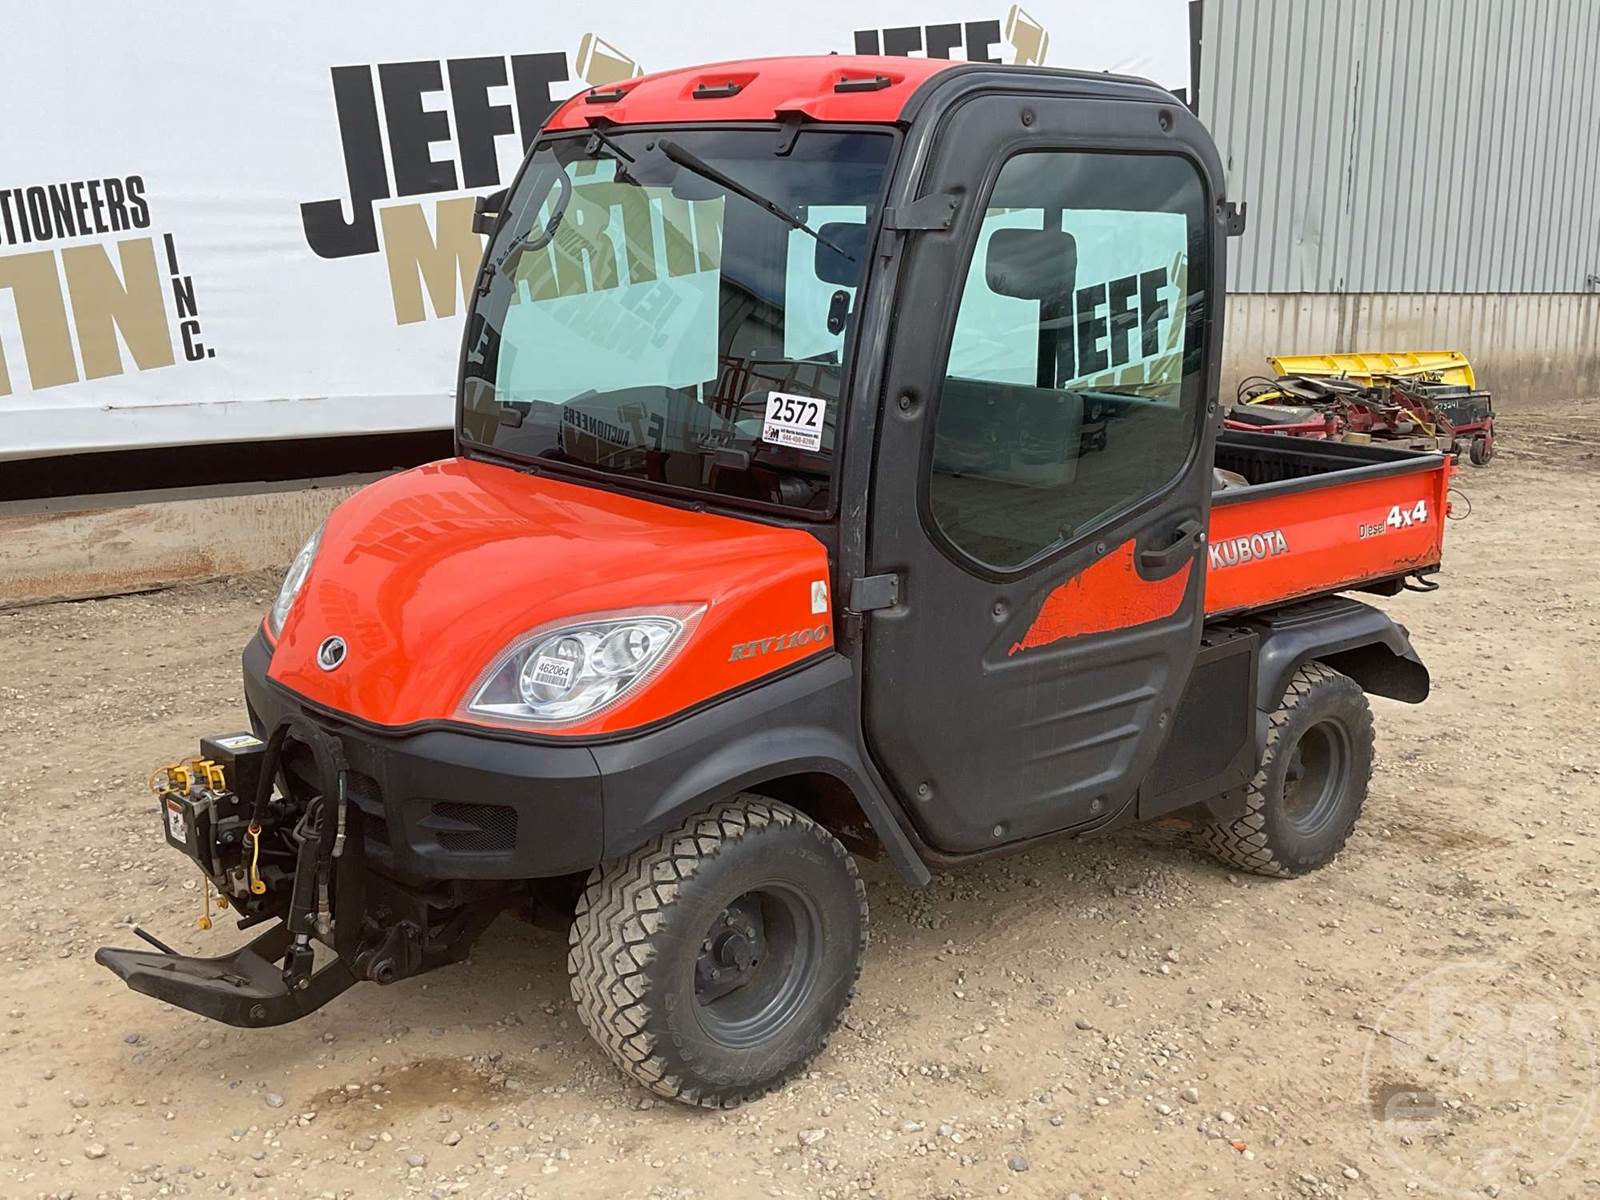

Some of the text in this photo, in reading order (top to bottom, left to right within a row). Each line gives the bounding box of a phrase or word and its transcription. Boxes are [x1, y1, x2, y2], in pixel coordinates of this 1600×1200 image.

[300, 51, 570, 259] JEFF
[0, 175, 151, 246] TIONEERS
[771, 397, 818, 427] 2572
[1358, 499, 1428, 540] Diesel 4x4
[1208, 529, 1290, 570] KUBOTA
[728, 625, 829, 662] RTV1100
[539, 663, 570, 677] 462064
